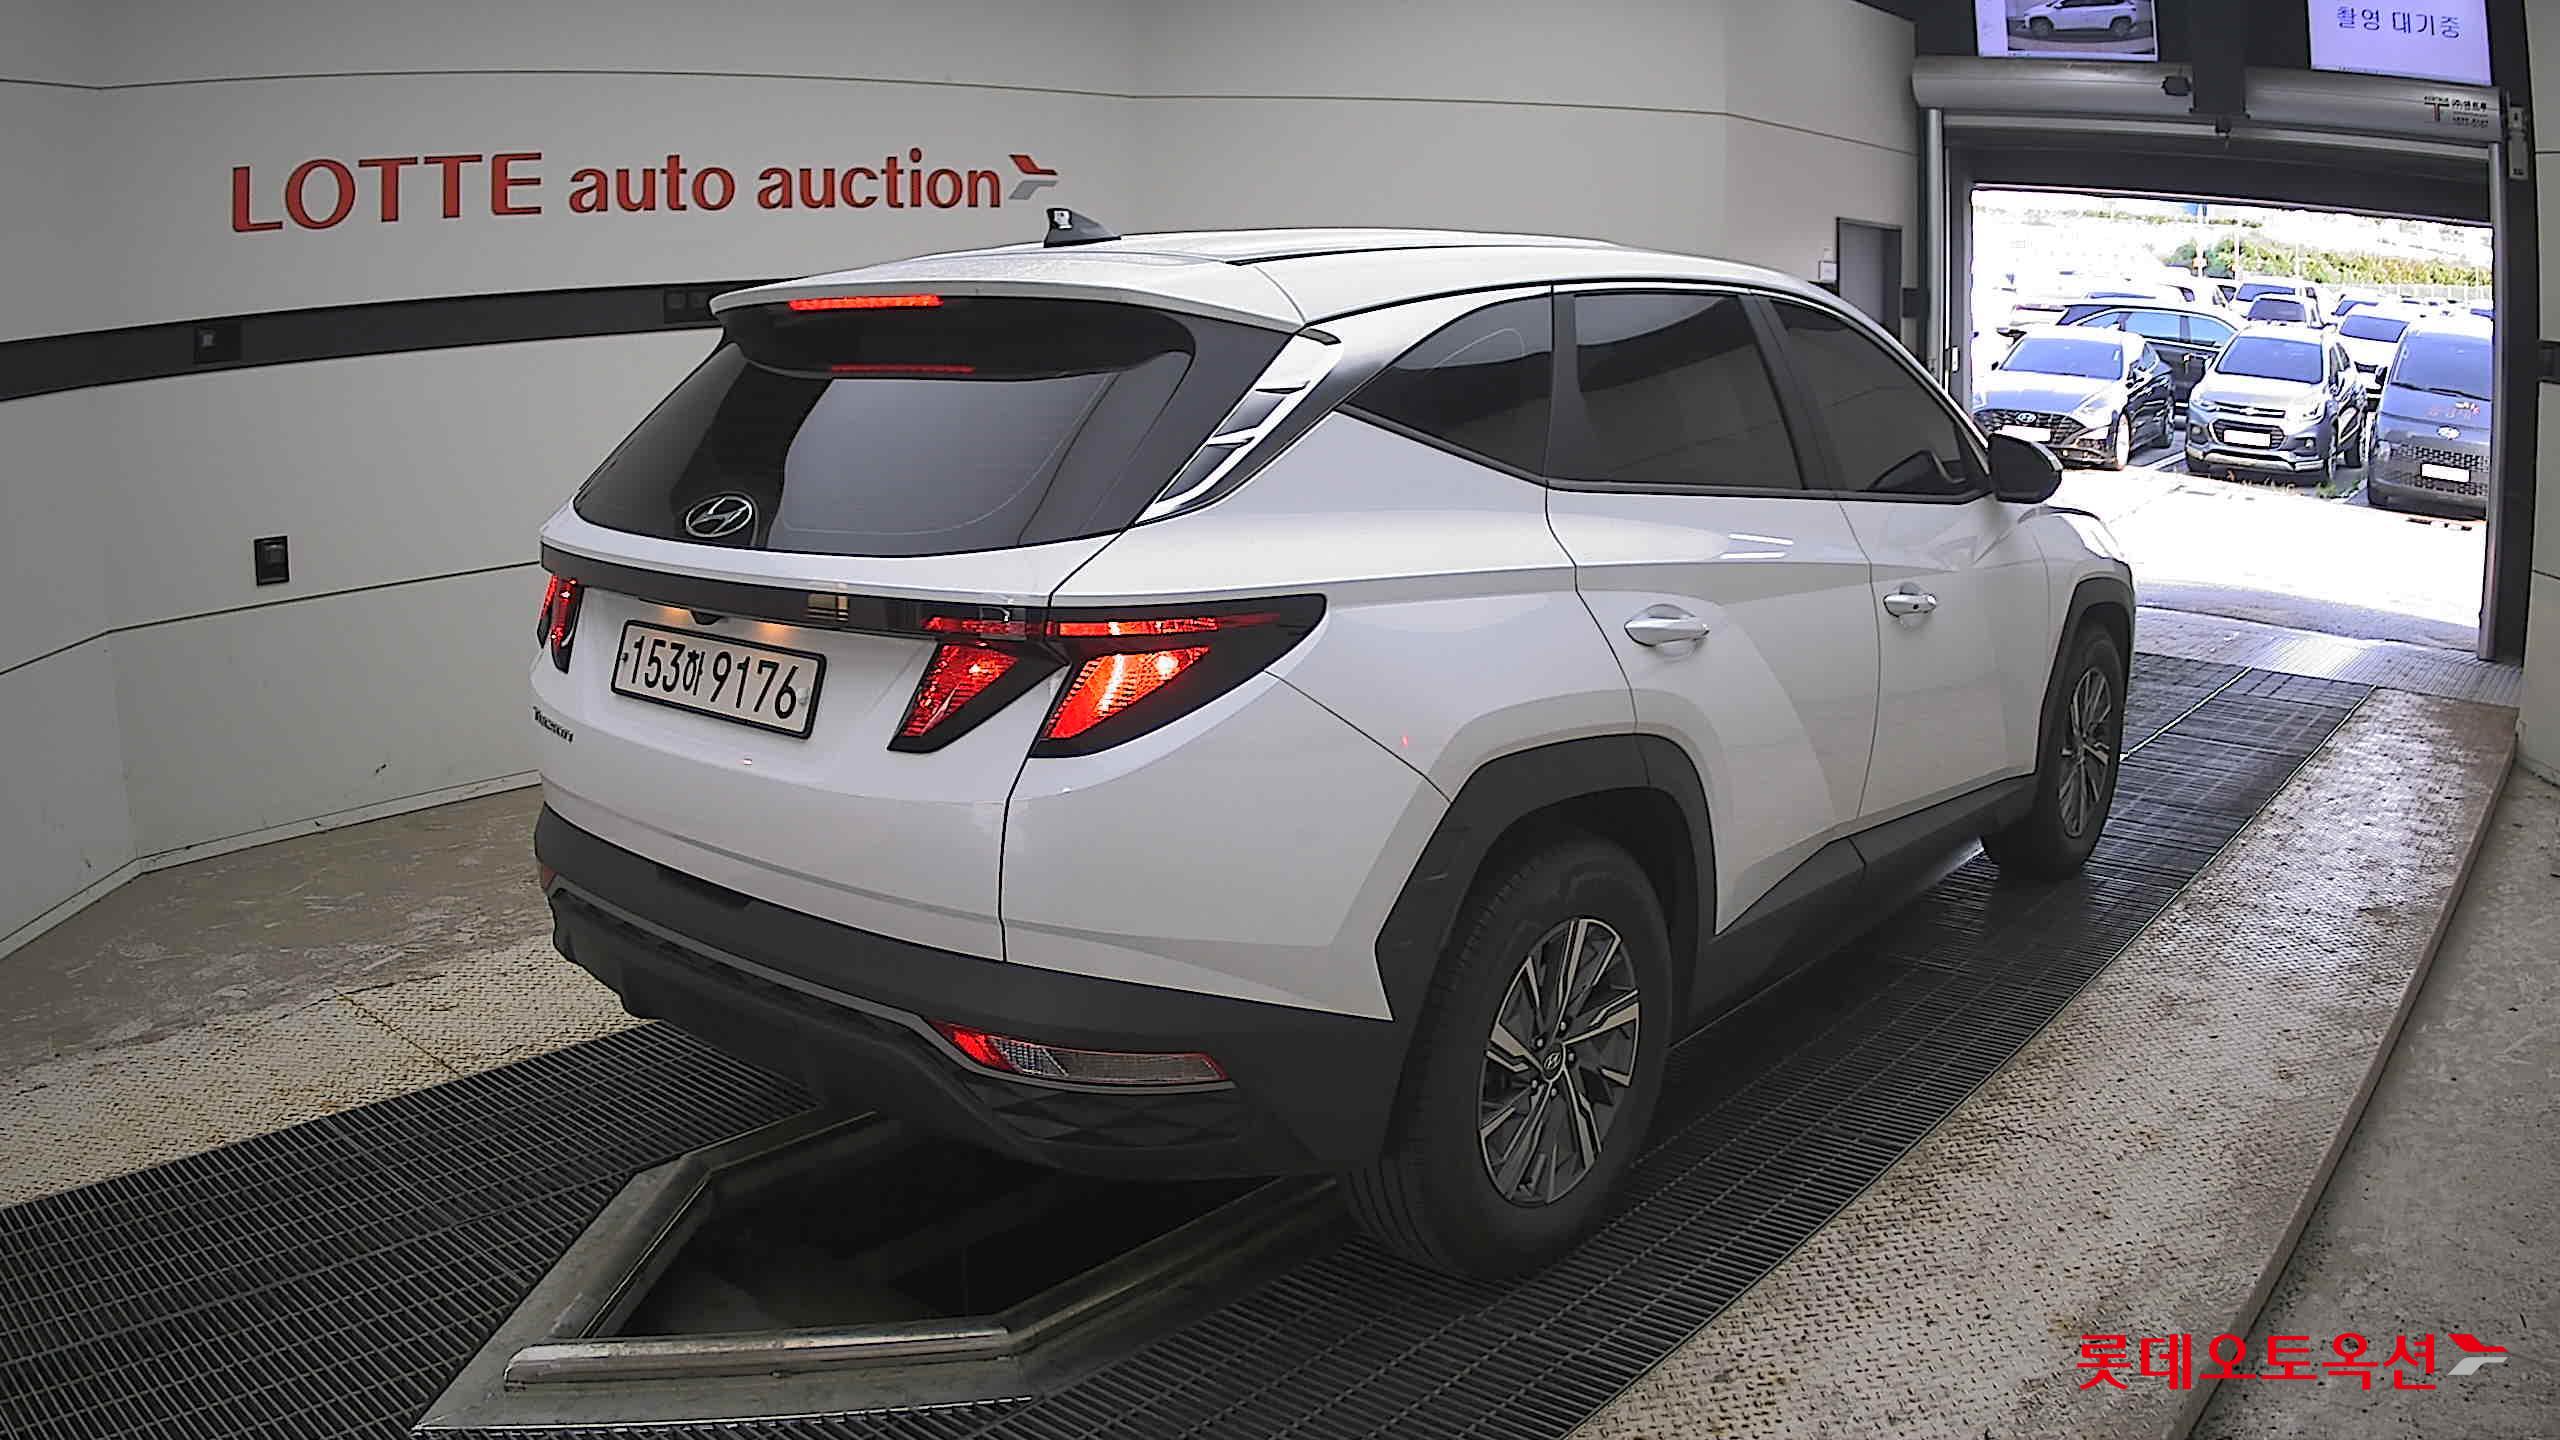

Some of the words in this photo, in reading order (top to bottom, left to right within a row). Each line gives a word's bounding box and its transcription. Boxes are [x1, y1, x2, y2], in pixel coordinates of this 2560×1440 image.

[2337, 6, 2381, 31] 촬영
[2392, 11, 2461, 39] 대기중
[232, 152, 543, 233] LOTTE
[568, 154, 736, 213] auto
[757, 147, 1003, 211] auction
[631, 635, 706, 696] 153하
[709, 651, 799, 720] 9176
